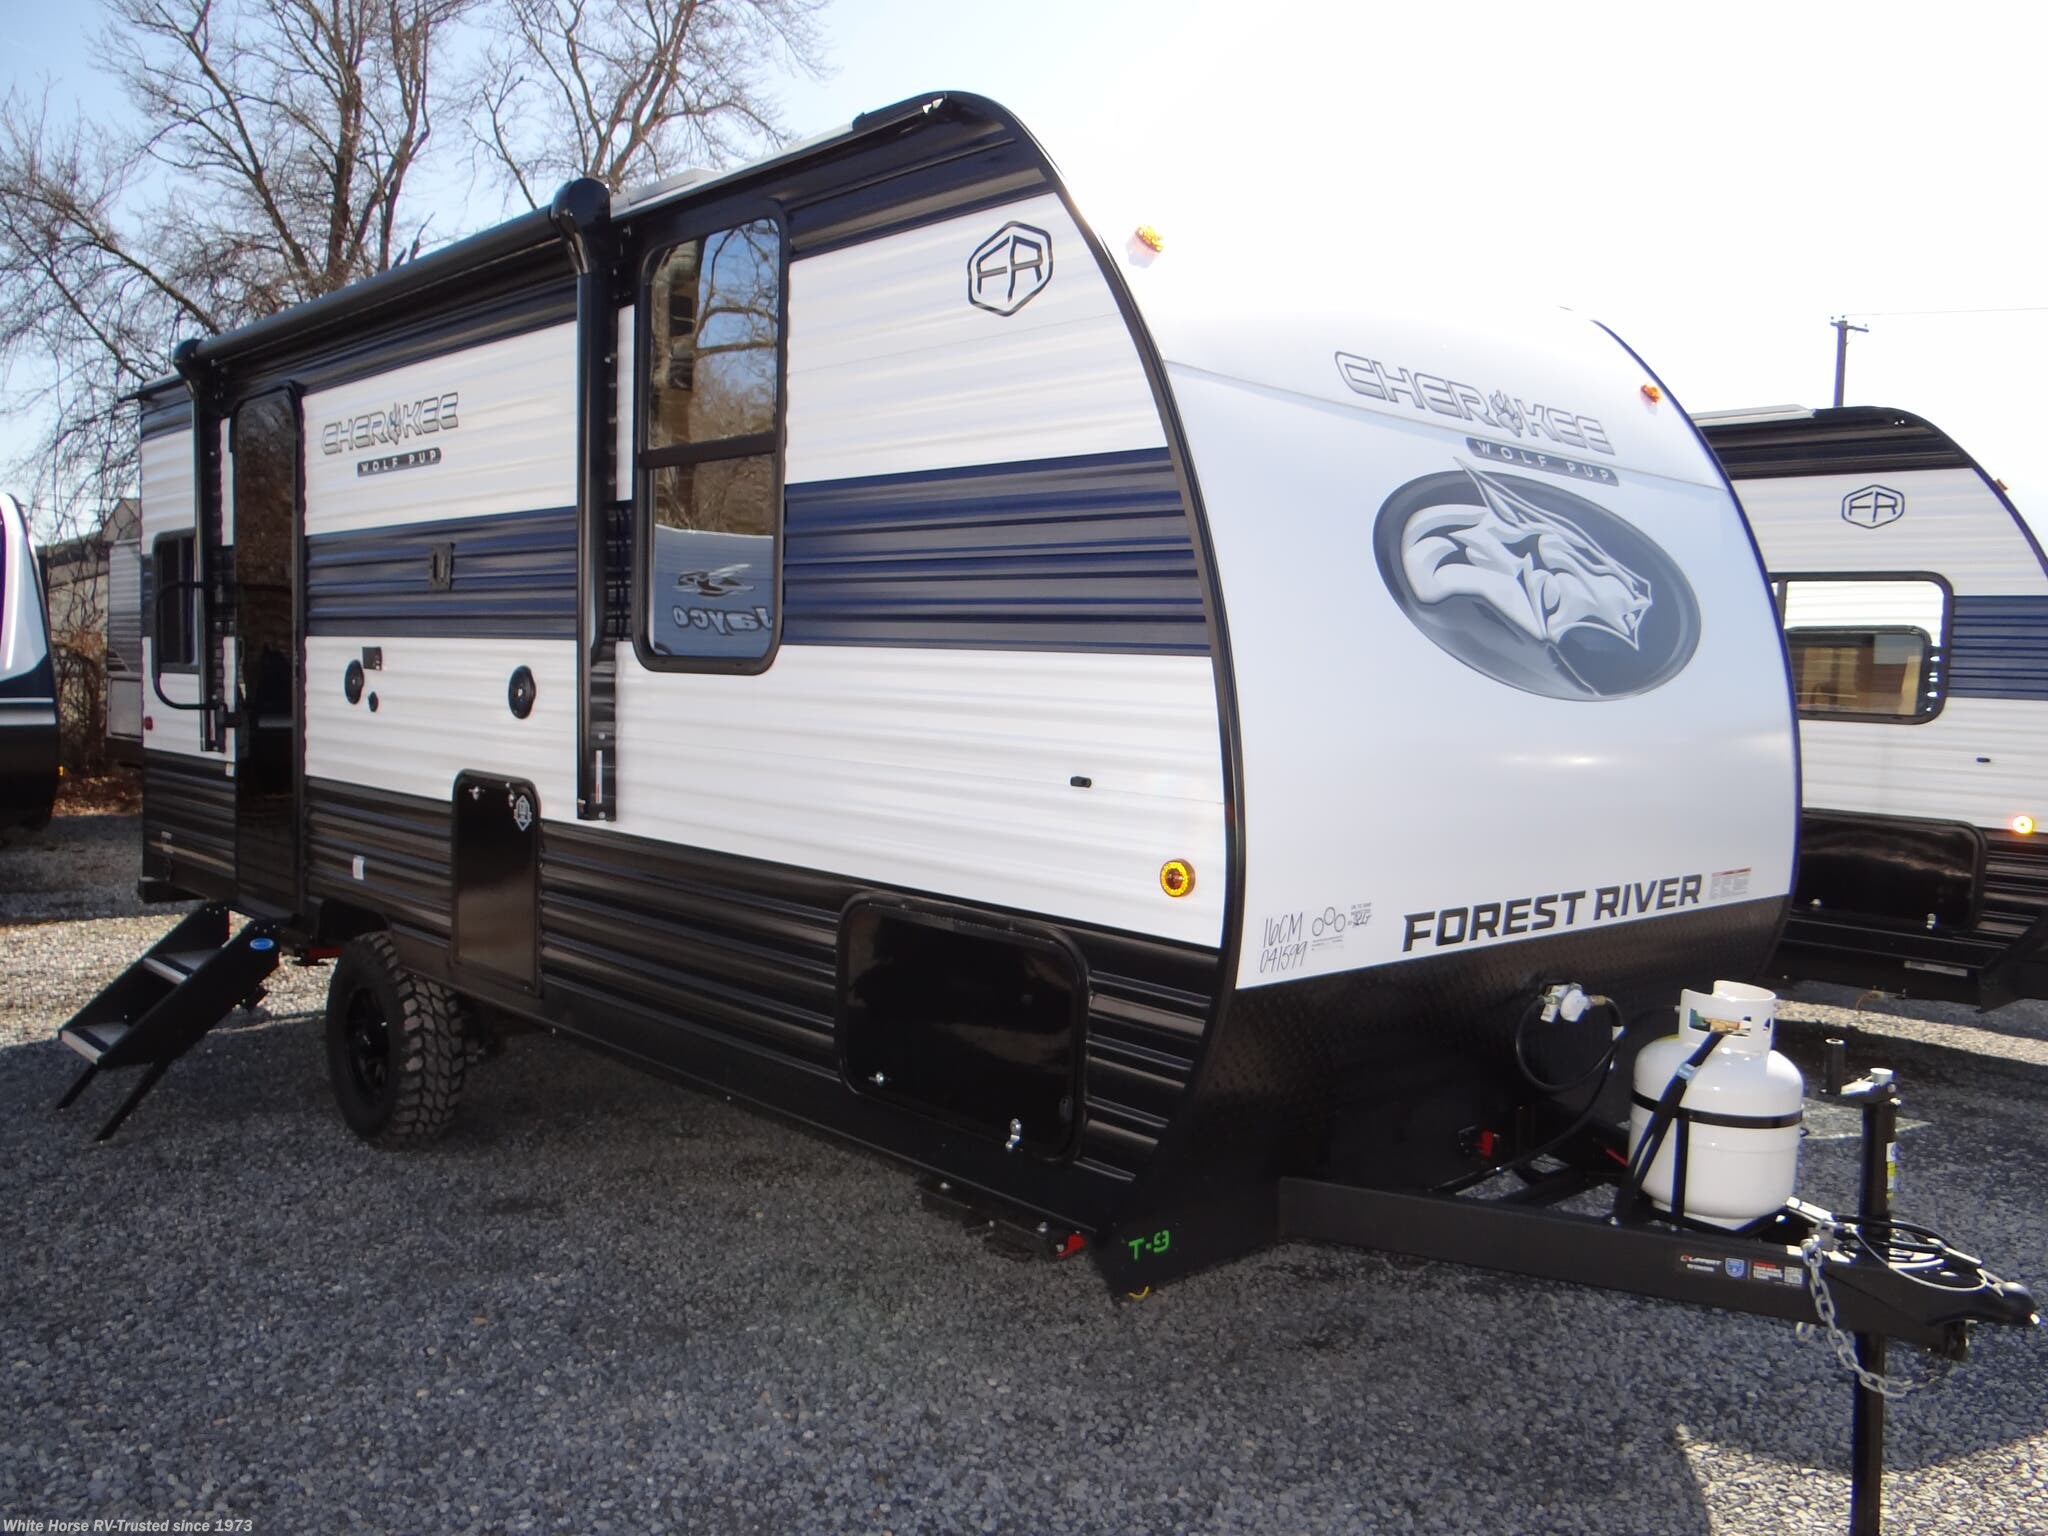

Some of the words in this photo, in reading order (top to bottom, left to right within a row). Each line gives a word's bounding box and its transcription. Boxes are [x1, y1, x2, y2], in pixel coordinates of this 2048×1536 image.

[320, 391, 460, 456] CHEROKEE
[1333, 350, 1616, 456] CHEROKEE
[360, 457, 399, 473] WOLF
[408, 449, 437, 465] PUP
[1475, 440, 1548, 468] WOLF
[1564, 461, 1610, 482] PUP
[1402, 890, 1587, 953] FOREST
[1593, 873, 1703, 921] RIVER
[1127, 1229, 1170, 1261] T-9
